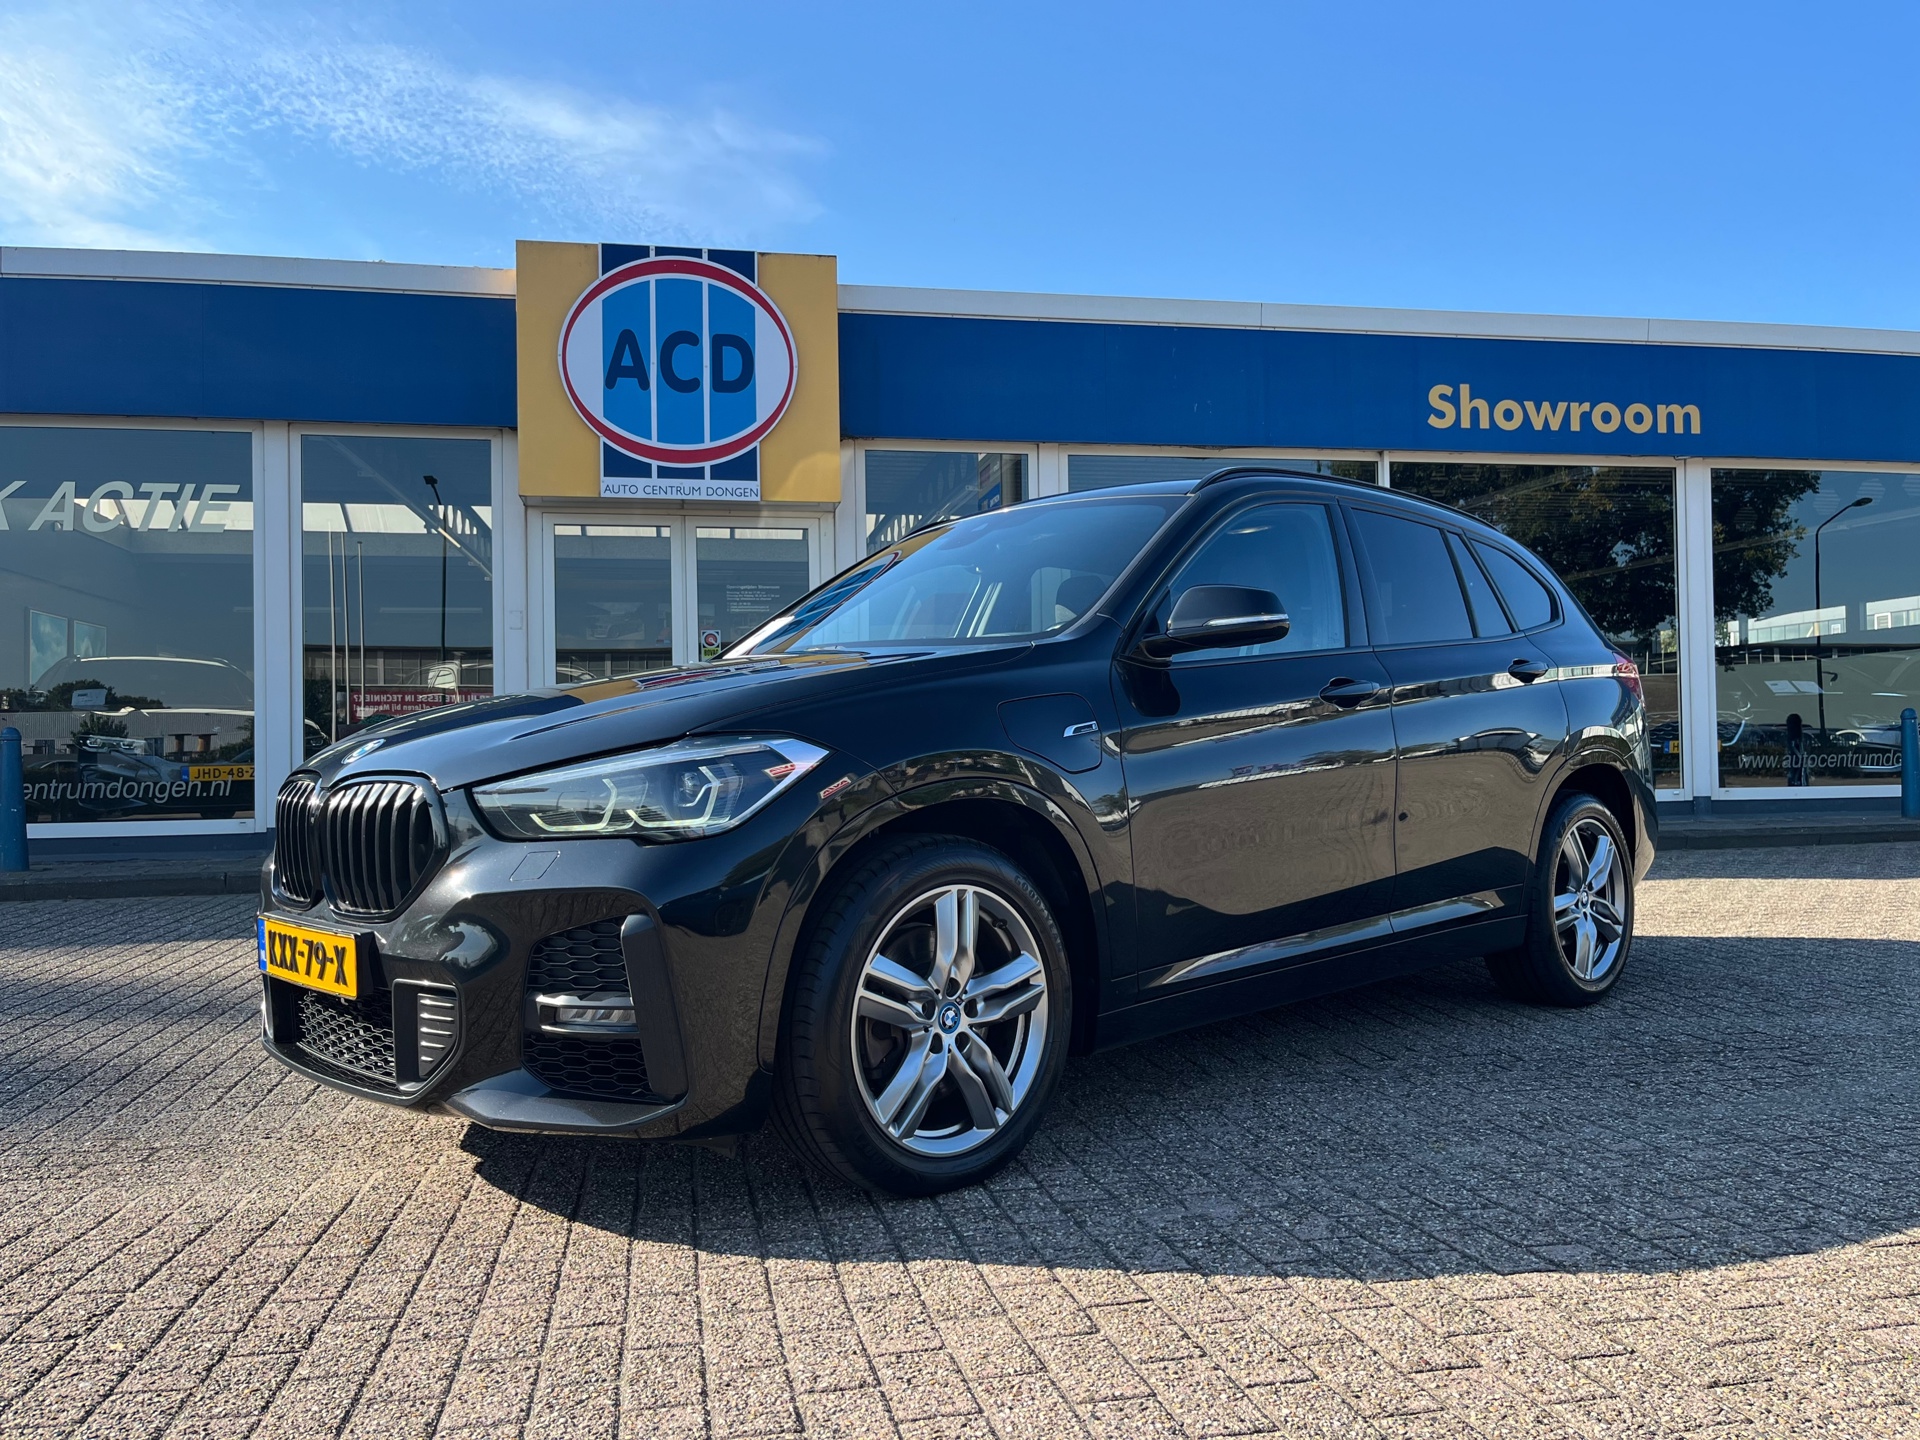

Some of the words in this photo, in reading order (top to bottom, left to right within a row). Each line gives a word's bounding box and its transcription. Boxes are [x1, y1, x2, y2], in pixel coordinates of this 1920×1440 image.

[605, 328, 755, 394] ACD
[1427, 383, 1701, 435] Showroom
[27, 480, 241, 533] ACTIE
[603, 484, 639, 495] AUTO
[643, 485, 702, 496] CENTRUM
[706, 487, 759, 498] DONGEN
[268, 929, 349, 988] KXX-79-X
